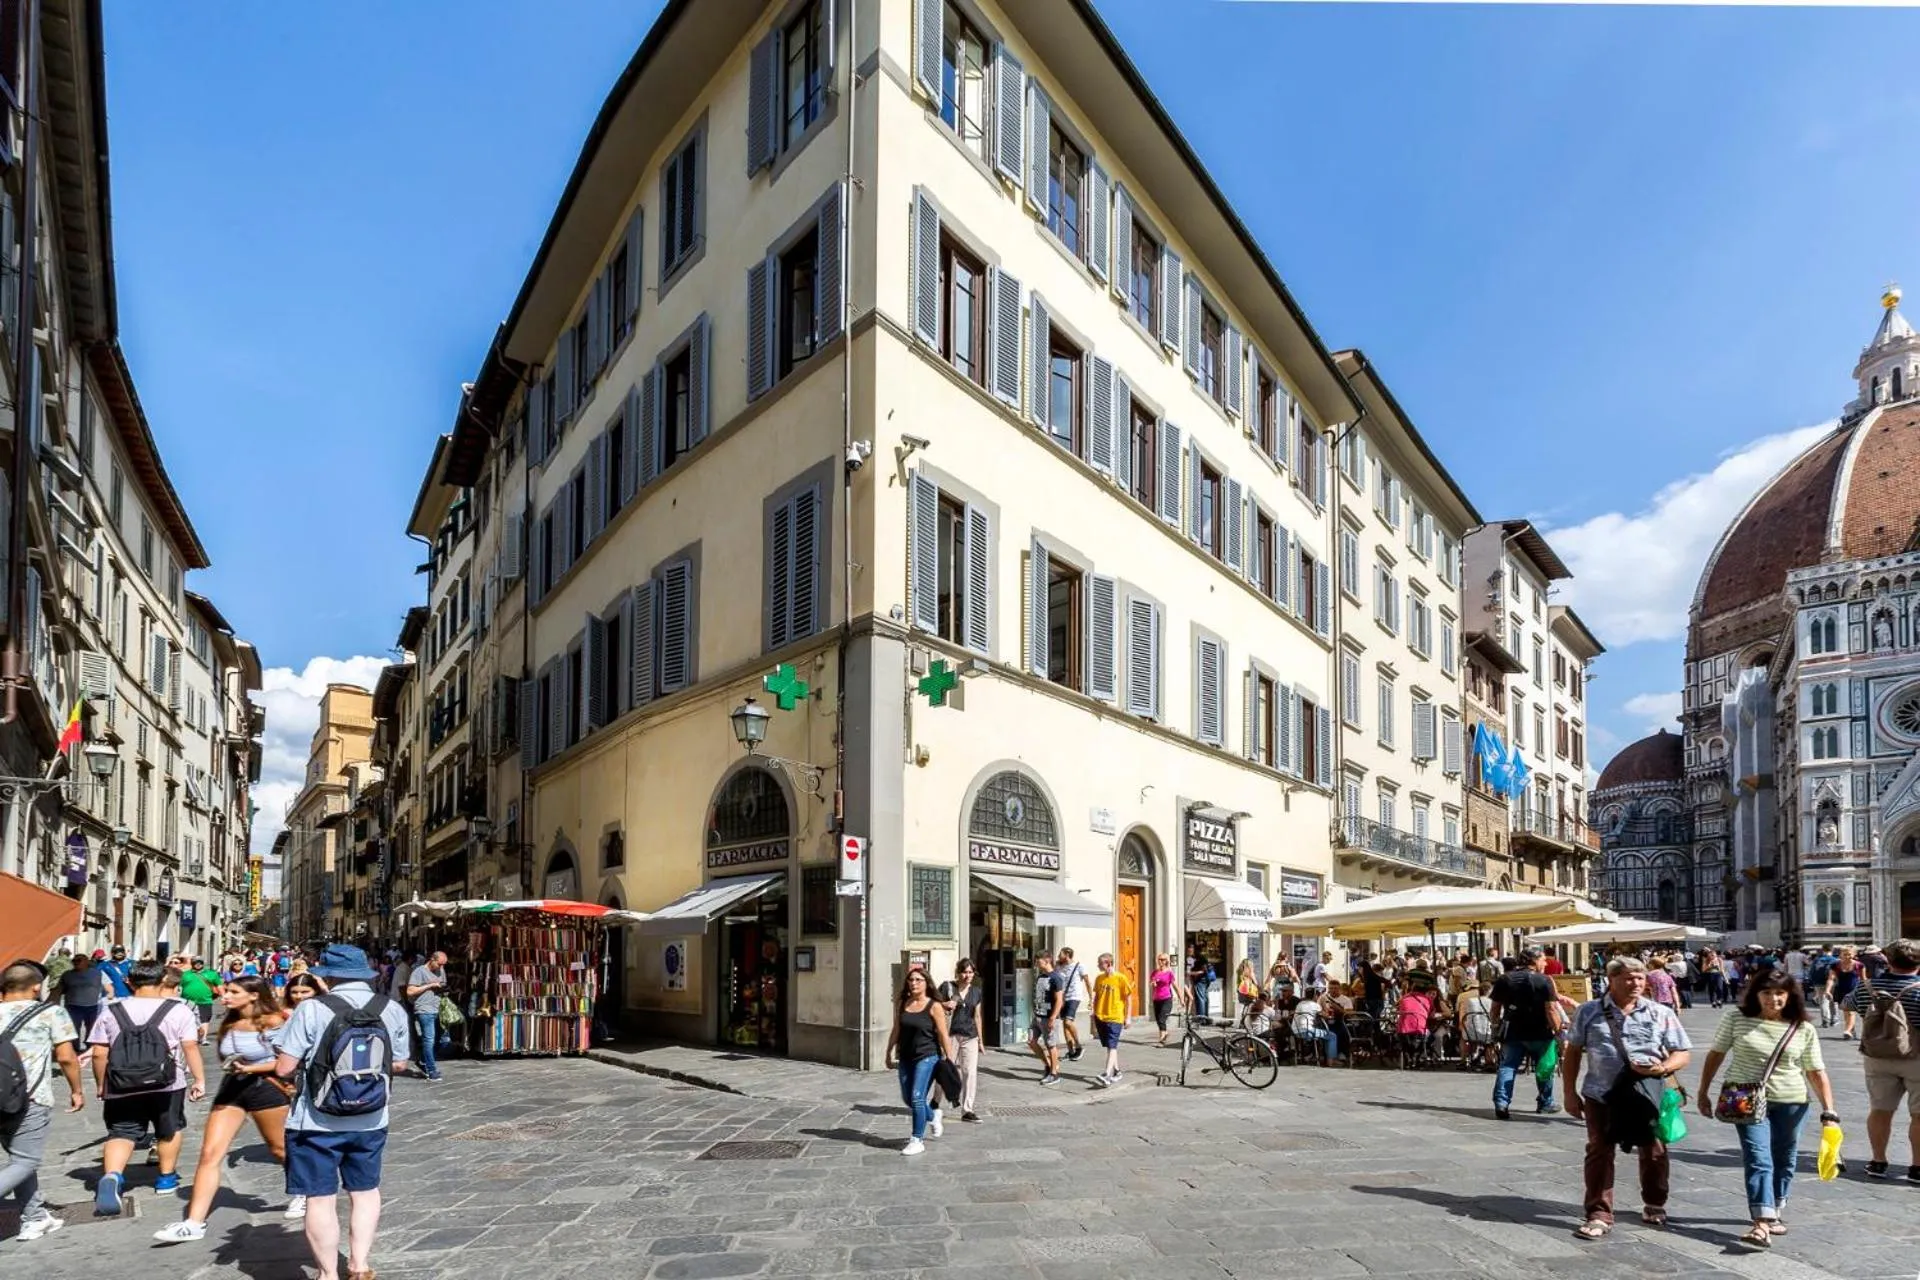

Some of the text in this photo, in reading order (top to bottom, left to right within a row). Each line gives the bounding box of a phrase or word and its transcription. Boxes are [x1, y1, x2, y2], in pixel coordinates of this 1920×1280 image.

[1189, 819, 1235, 845] PIZZA
[715, 843, 781, 865] FARMACIA
[979, 844, 1052, 867] FARMACIA
